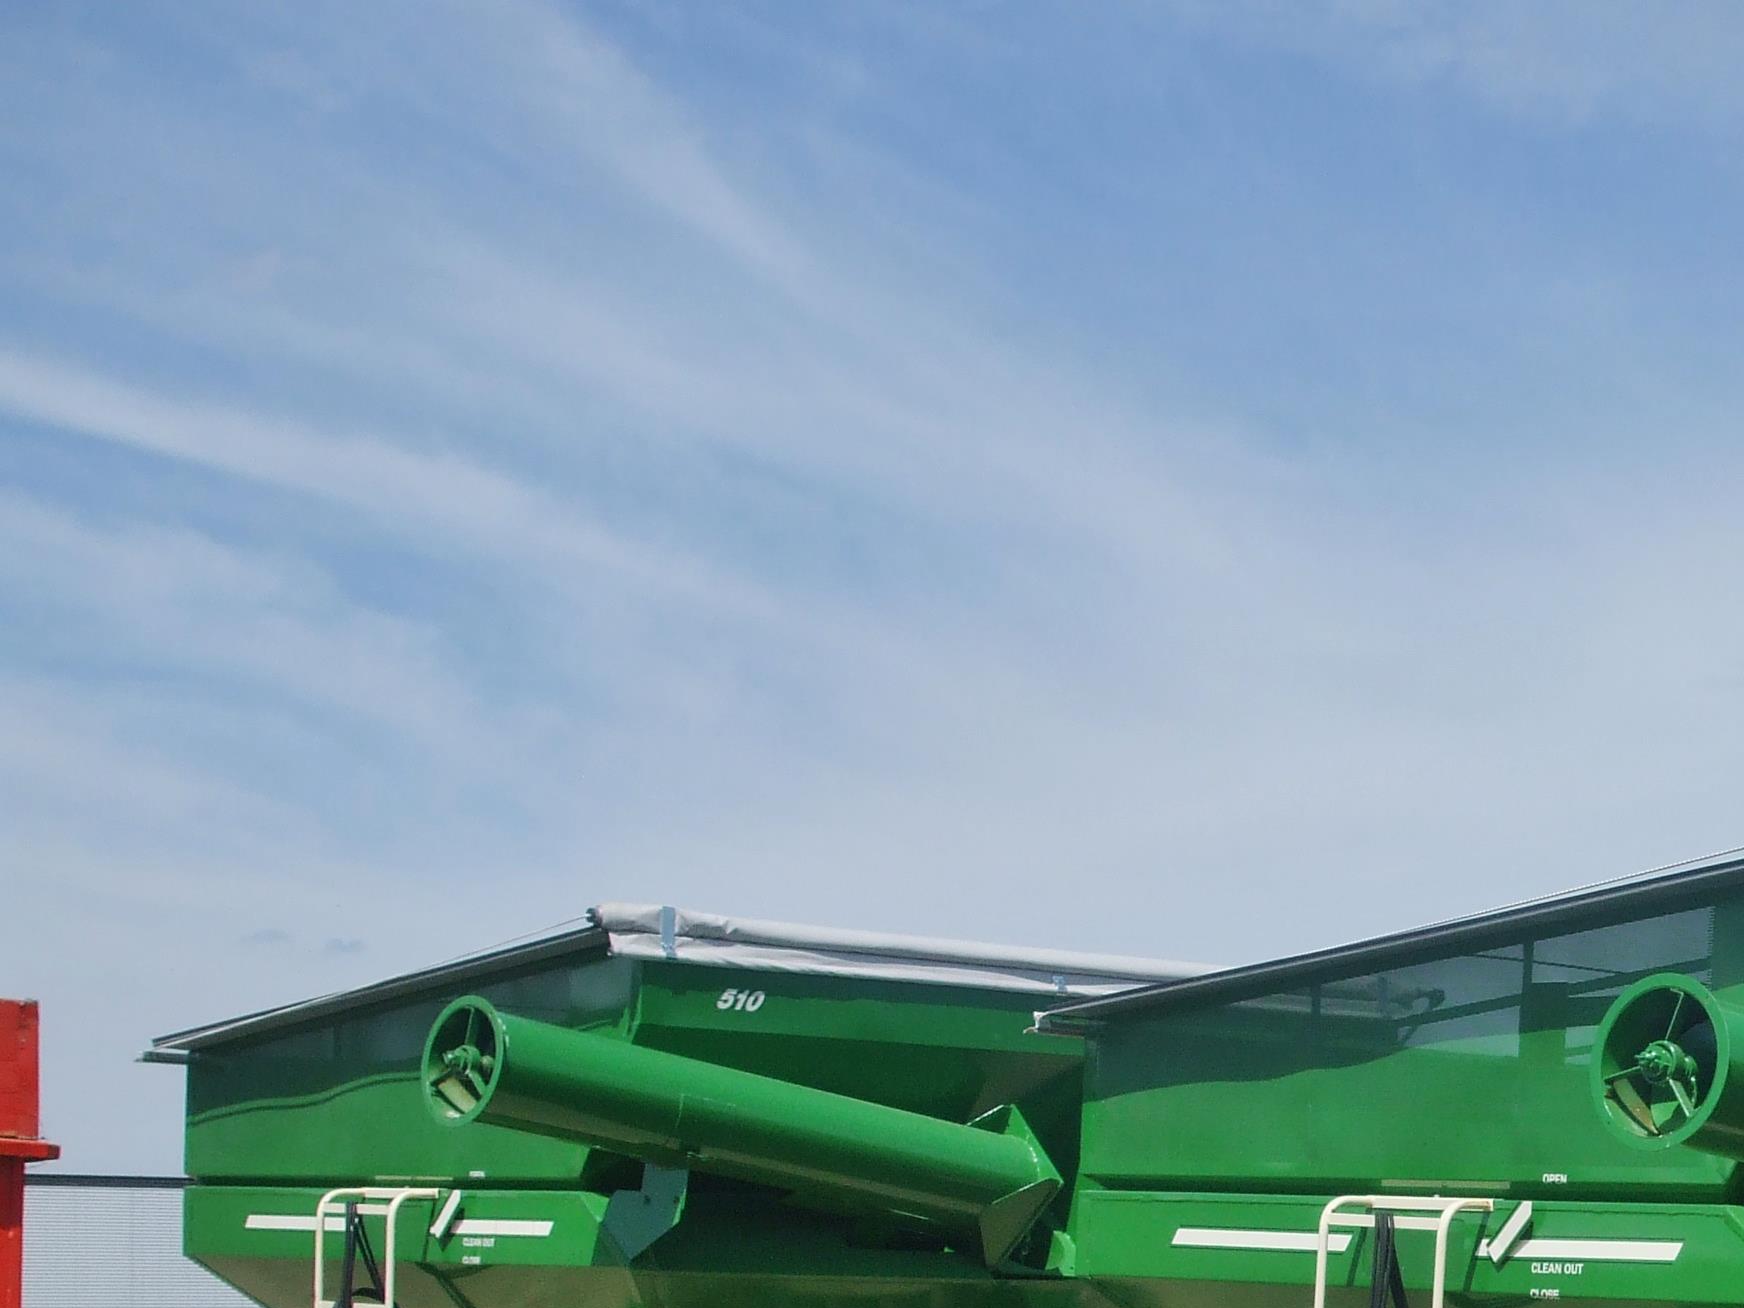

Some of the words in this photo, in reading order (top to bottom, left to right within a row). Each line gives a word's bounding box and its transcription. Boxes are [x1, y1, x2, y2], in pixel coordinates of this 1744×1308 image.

[716, 988, 765, 1012] 510
[1542, 1173, 1568, 1184] OPEN
[1531, 1262, 1562, 1275] CLEAN
[1564, 1263, 1584, 1275] OUT
[1530, 1288, 1560, 1300] CLOSE
